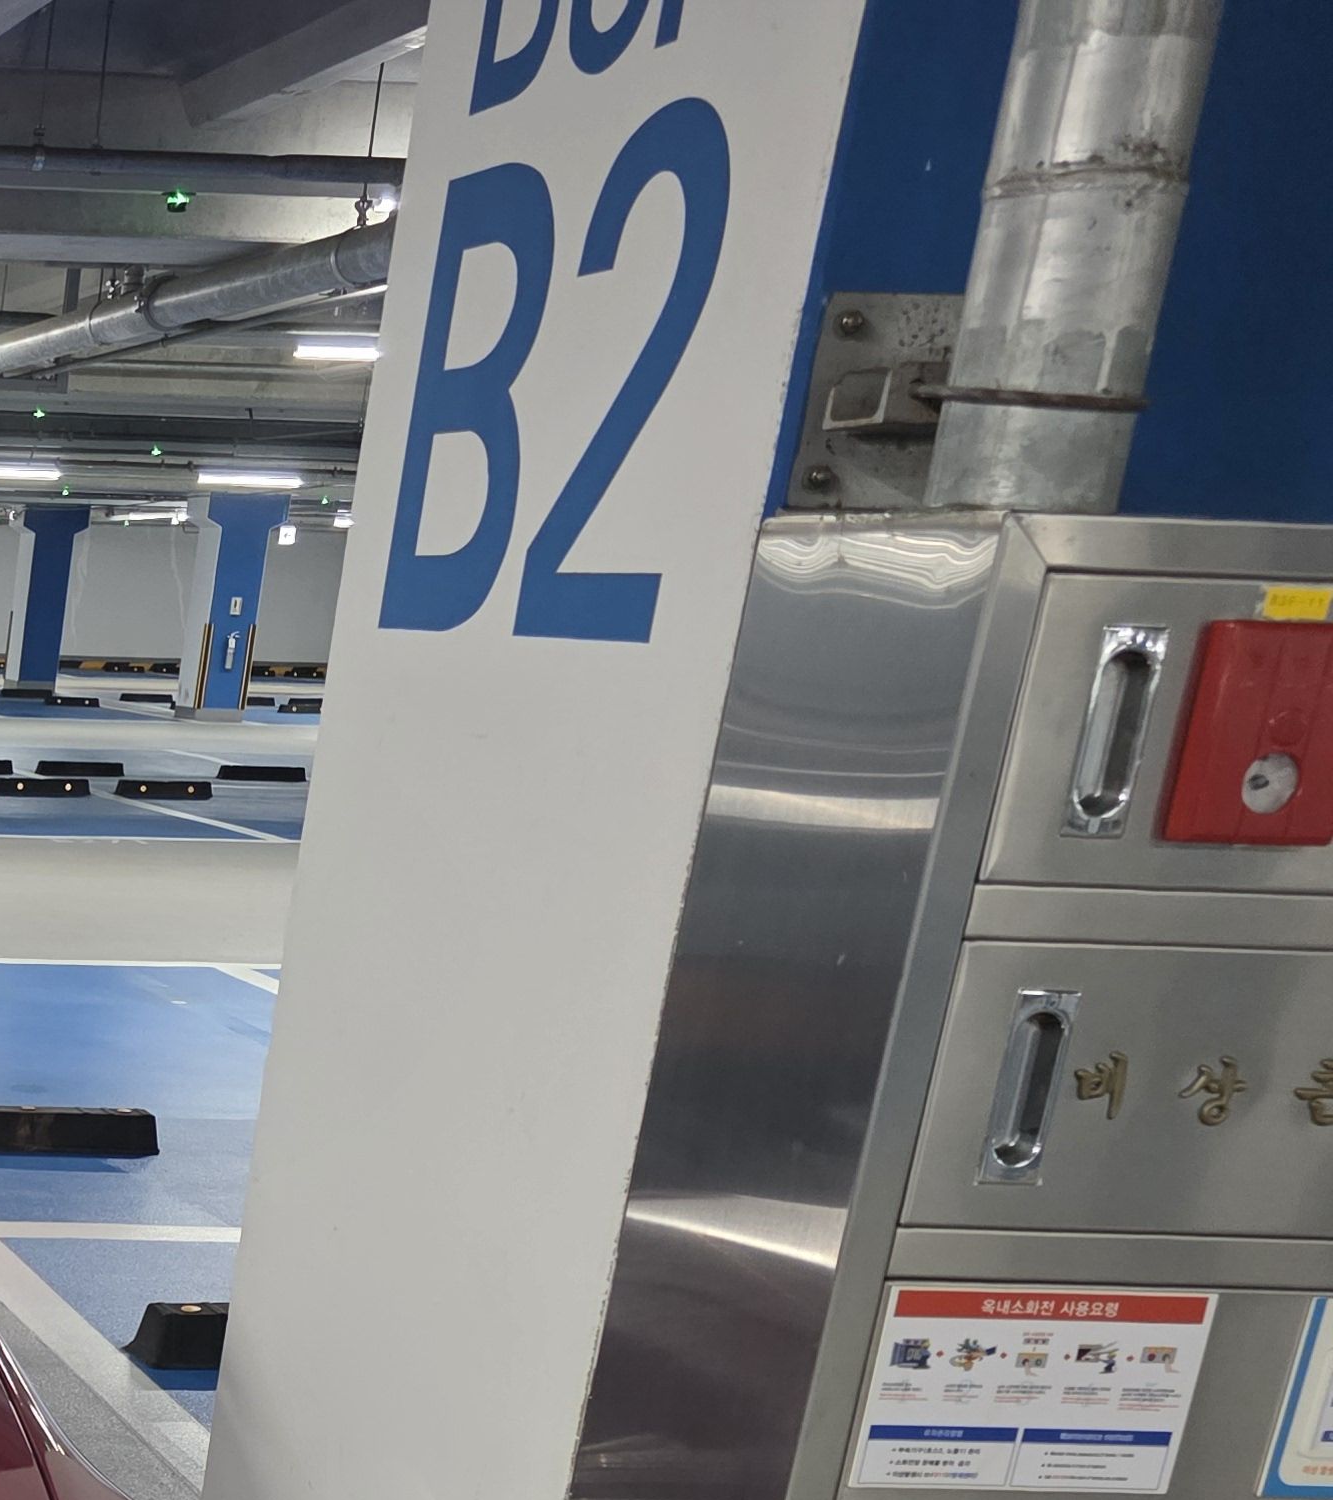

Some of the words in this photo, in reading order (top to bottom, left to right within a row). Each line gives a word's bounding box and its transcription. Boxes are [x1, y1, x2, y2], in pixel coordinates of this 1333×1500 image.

[378, 97, 731, 643] B2
[981, 1298, 1056, 1317] 옥내소화전
[1060, 1301, 1121, 1318] 사용요령
